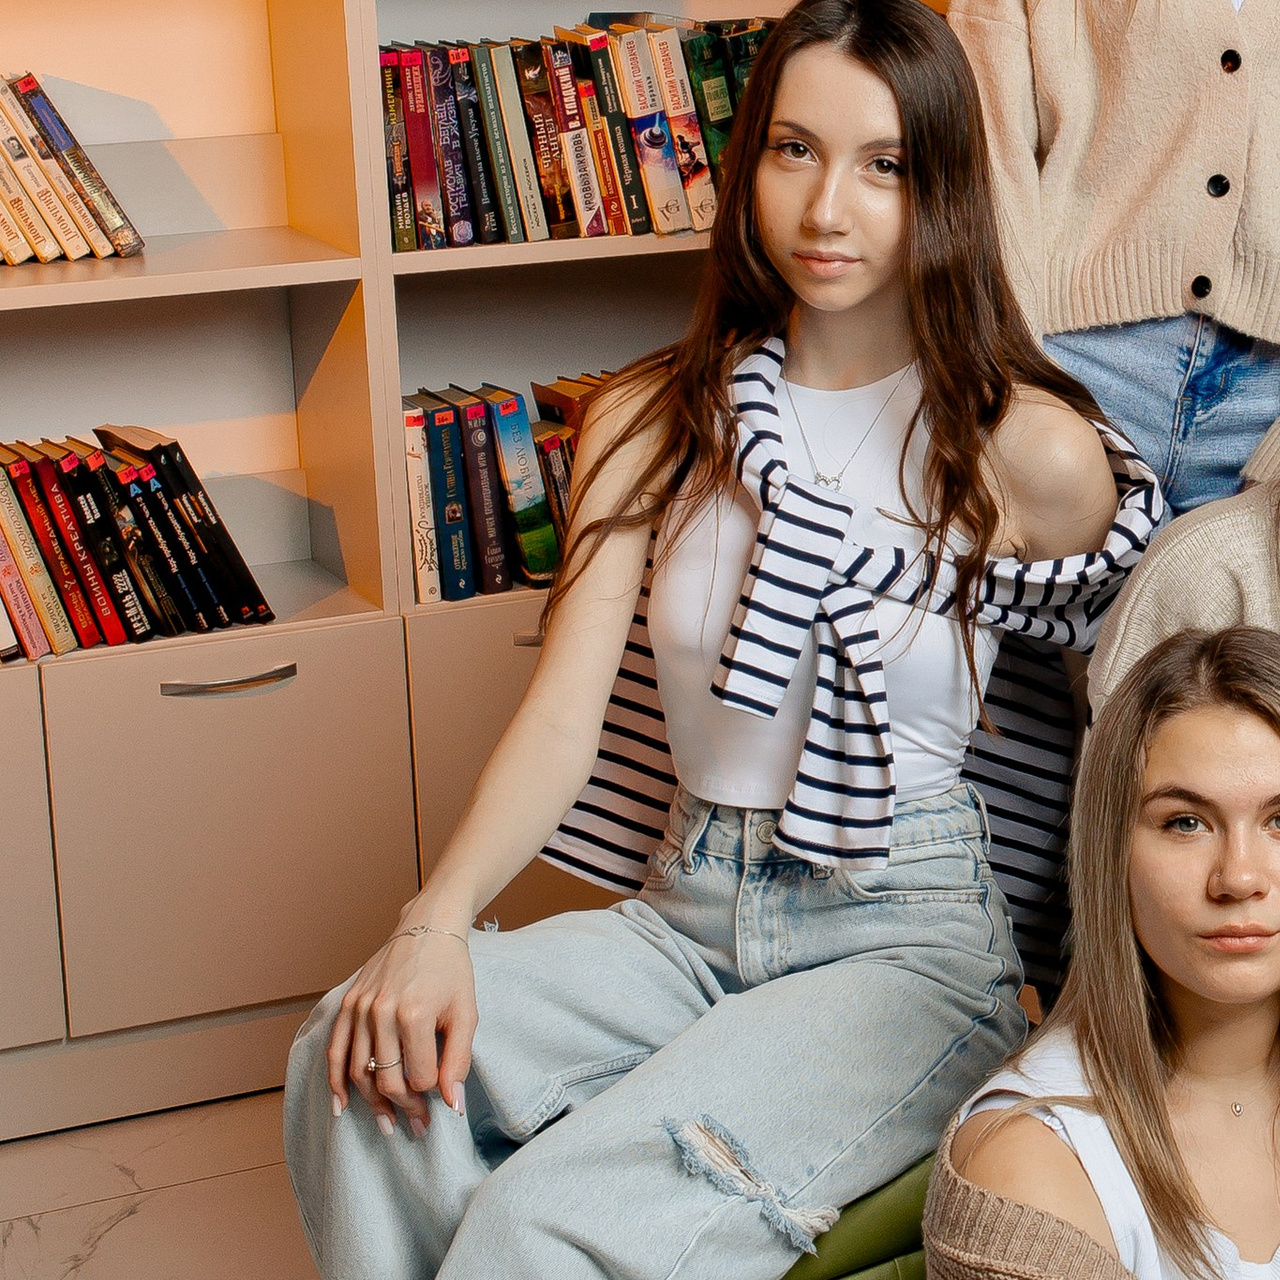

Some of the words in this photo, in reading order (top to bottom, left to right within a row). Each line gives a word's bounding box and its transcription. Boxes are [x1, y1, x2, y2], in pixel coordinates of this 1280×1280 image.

[626, 40, 642, 78] ГОЛОВАЧЕВ
[658, 41, 674, 78] ГОЛОВАЧЕВ
[555, 67, 578, 115] ГЛАДКИЙ
[633, 80, 648, 110] ВАСИЛИЙ
[667, 79, 682, 110] ВАСИЛИЙ
[533, 113, 552, 167] ЧЕРНЫЙ
[568, 116, 580, 128] В.
[50, 483, 88, 560] КРЕАТИВА
